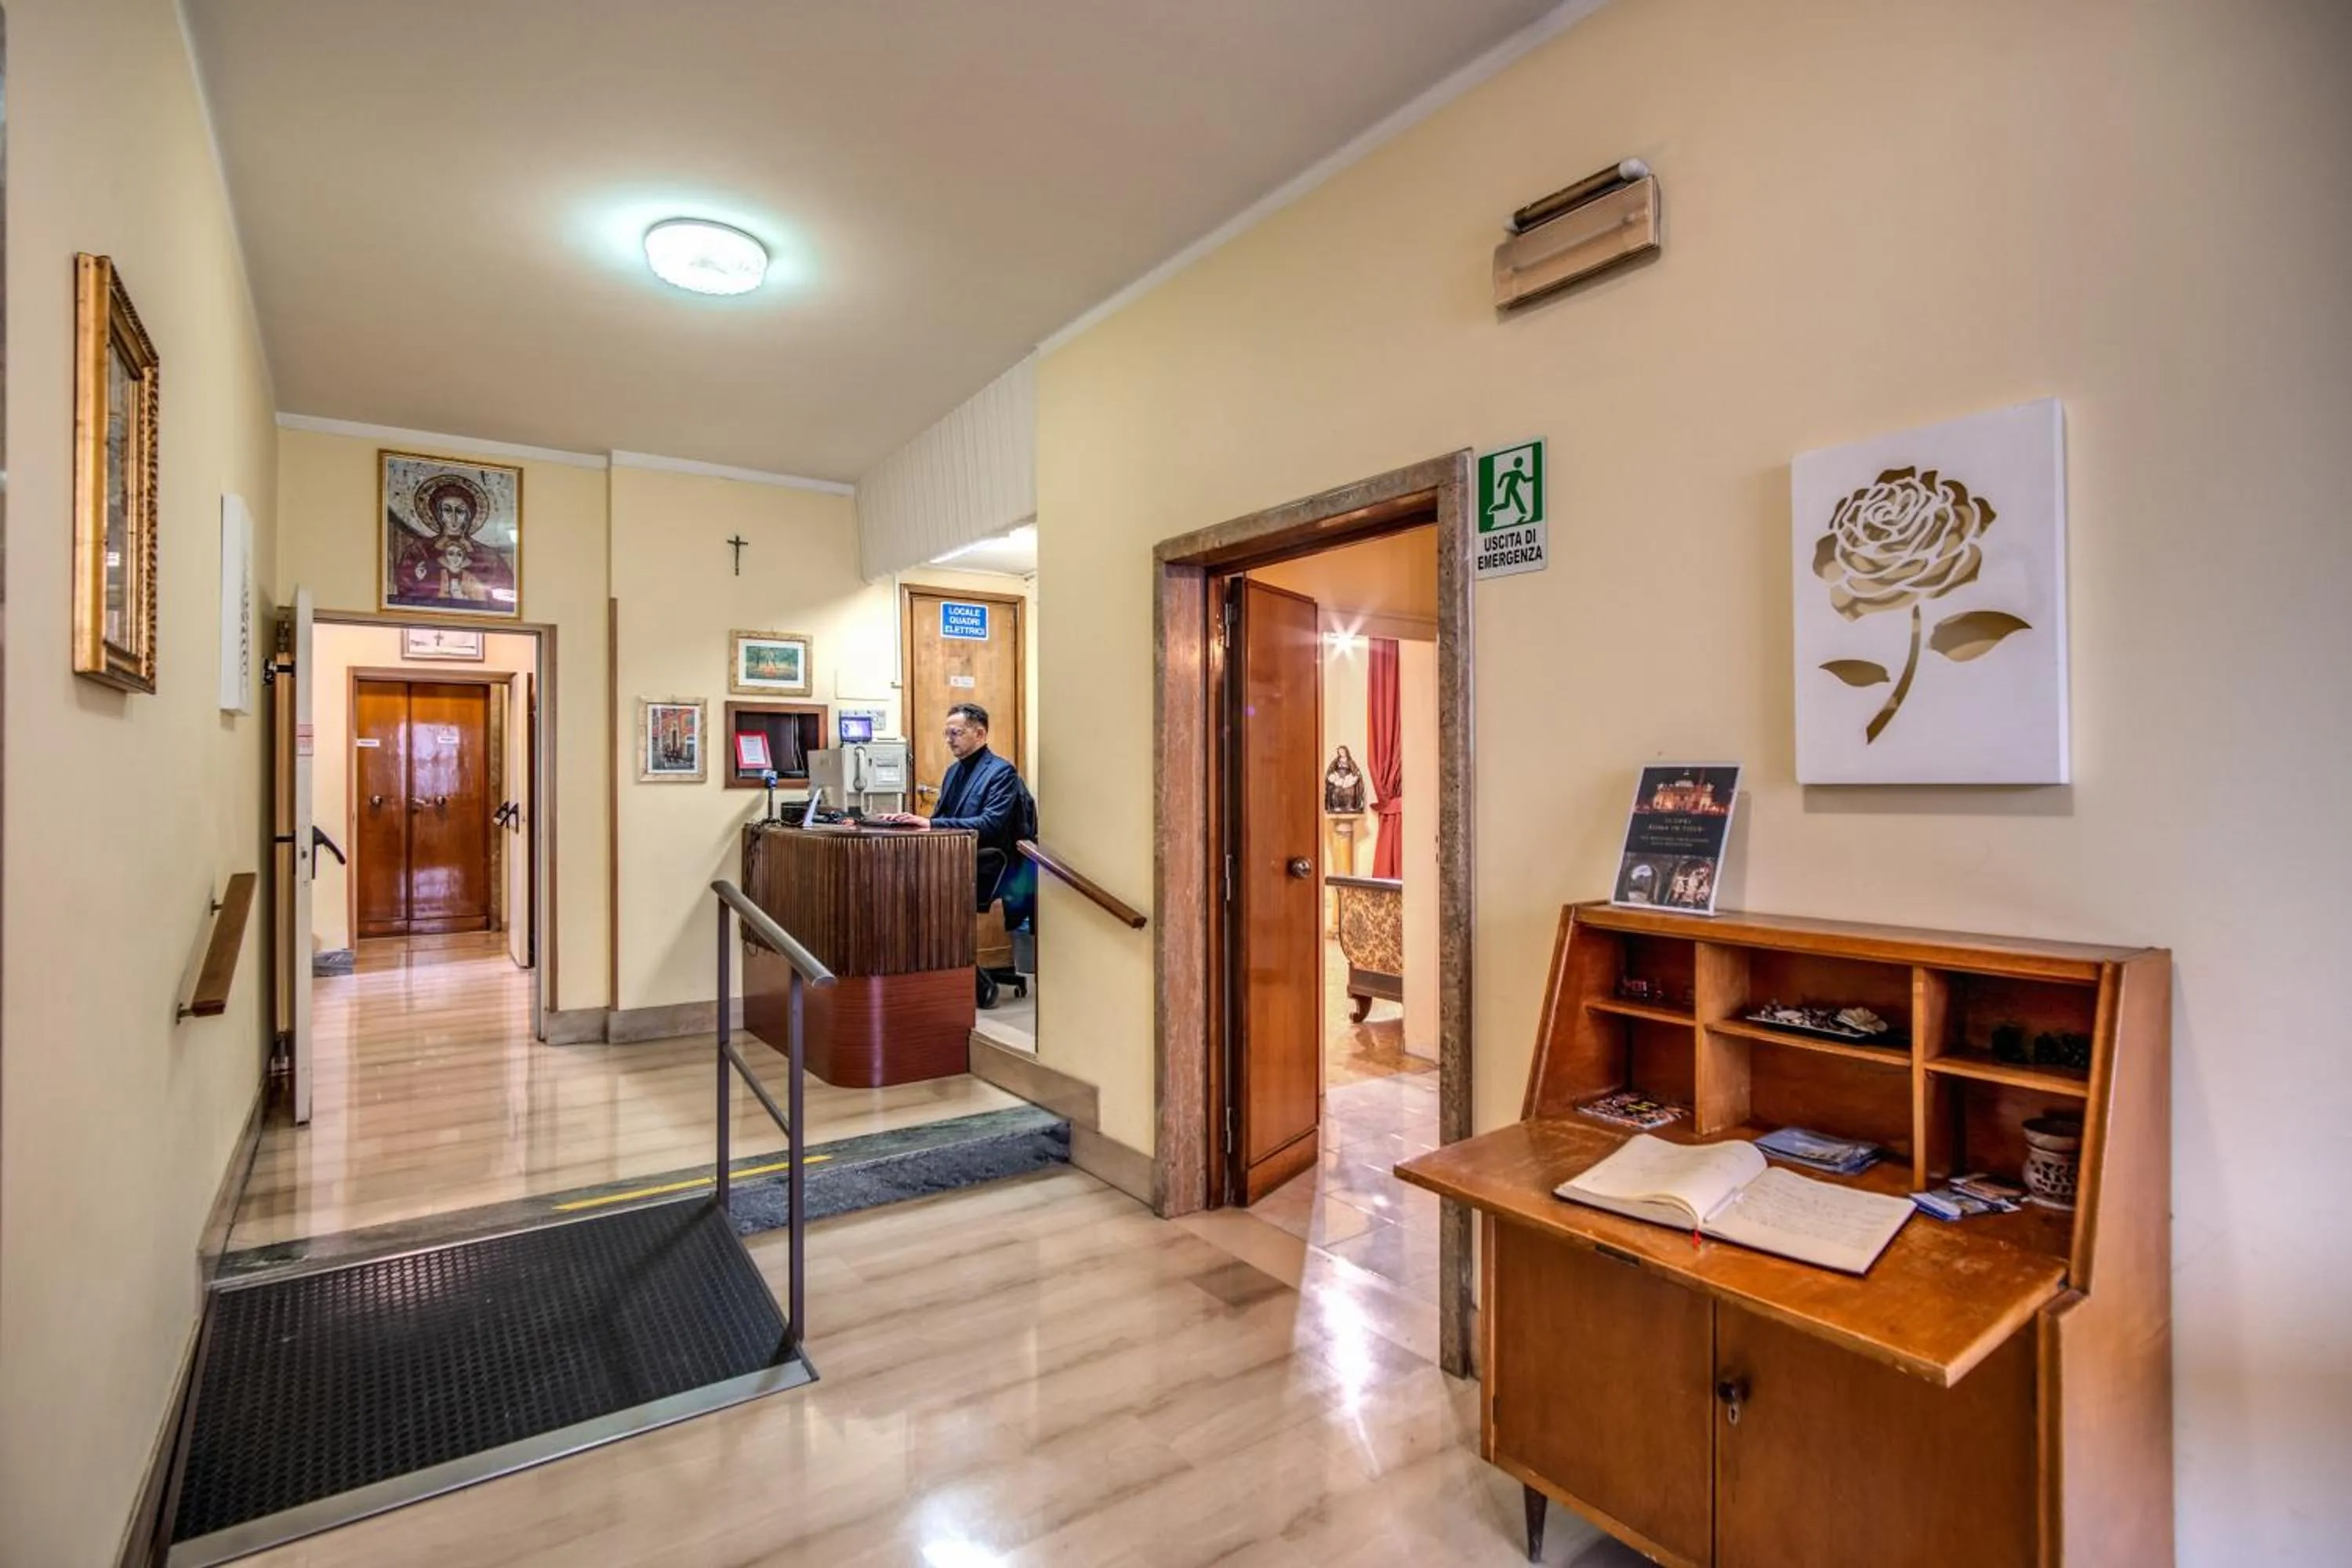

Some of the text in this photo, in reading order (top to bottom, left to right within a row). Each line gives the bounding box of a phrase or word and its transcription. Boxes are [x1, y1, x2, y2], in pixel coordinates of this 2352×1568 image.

[1484, 528, 1537, 552] USCITA DI
[1478, 546, 1542, 570] EMERGENZA
[948, 607, 981, 617] LOCALE
[949, 615, 981, 626] QUADRI
[945, 625, 985, 636] ELETTRICI
